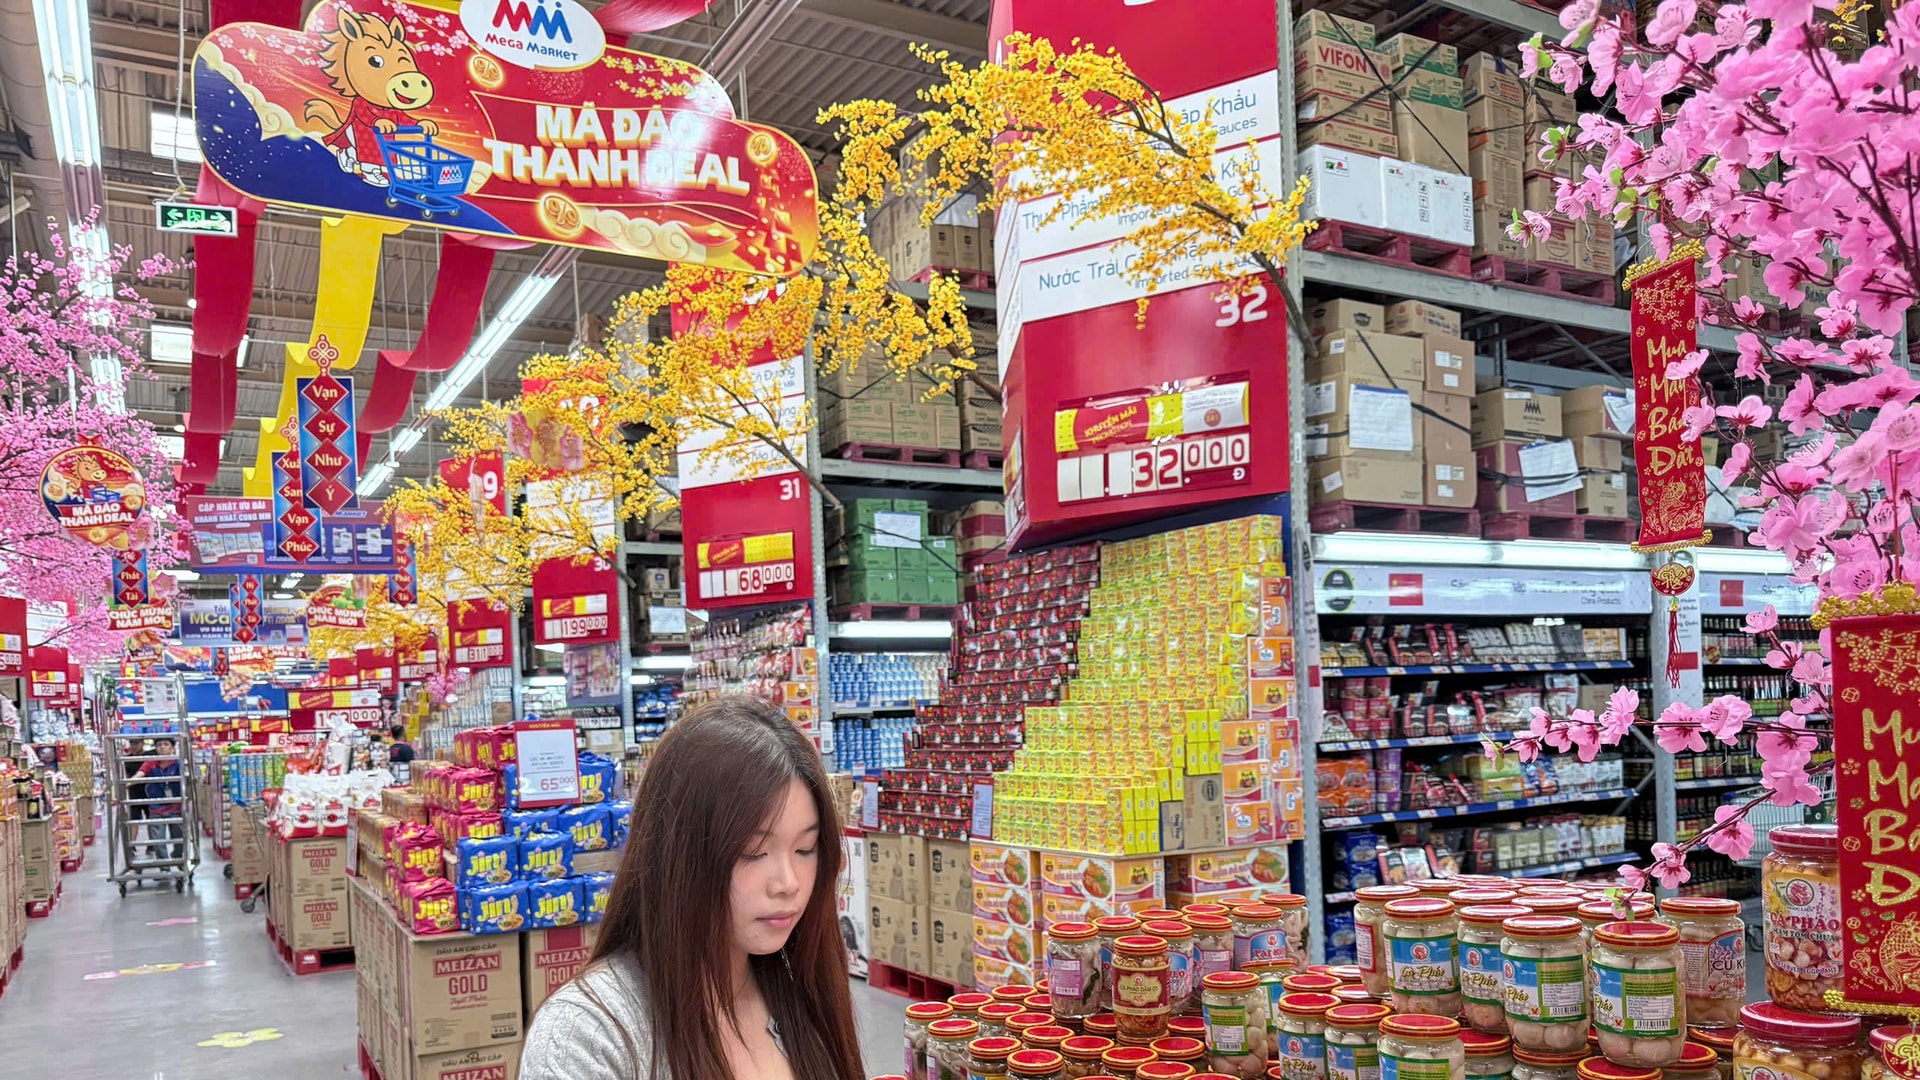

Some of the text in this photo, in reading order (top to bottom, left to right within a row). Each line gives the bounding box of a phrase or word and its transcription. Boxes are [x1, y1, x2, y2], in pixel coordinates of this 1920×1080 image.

[1318, 45, 1368, 74] VIFON
[536, 101, 699, 148] MÃ ĐÁO
[483, 138, 750, 196] THÀNH DEAL
[1039, 268, 1081, 291] Nước
[1214, 286, 1268, 328] 32
[1647, 337, 1687, 369] Mua
[312, 384, 338, 401] Vạn
[317, 419, 337, 437] Sự
[1648, 407, 1686, 442] Bá
[314, 453, 343, 468] Như
[1646, 443, 1694, 477] Đắt
[283, 486, 301, 499] San
[325, 485, 335, 501] Ý
[780, 479, 801, 501] 31
[103, 511, 135, 524] DEAL
[287, 513, 309, 527] Vạn
[286, 539, 313, 553] Phúc
[189, 612, 230, 625] MCa
[1862, 707, 1920, 758] Mu
[310, 858, 331, 868] GOLD
[311, 912, 332, 922] GOLD
[436, 956, 498, 974] MEIZAN
[538, 948, 592, 967] MEIZAN
[449, 974, 488, 996] GOLD
